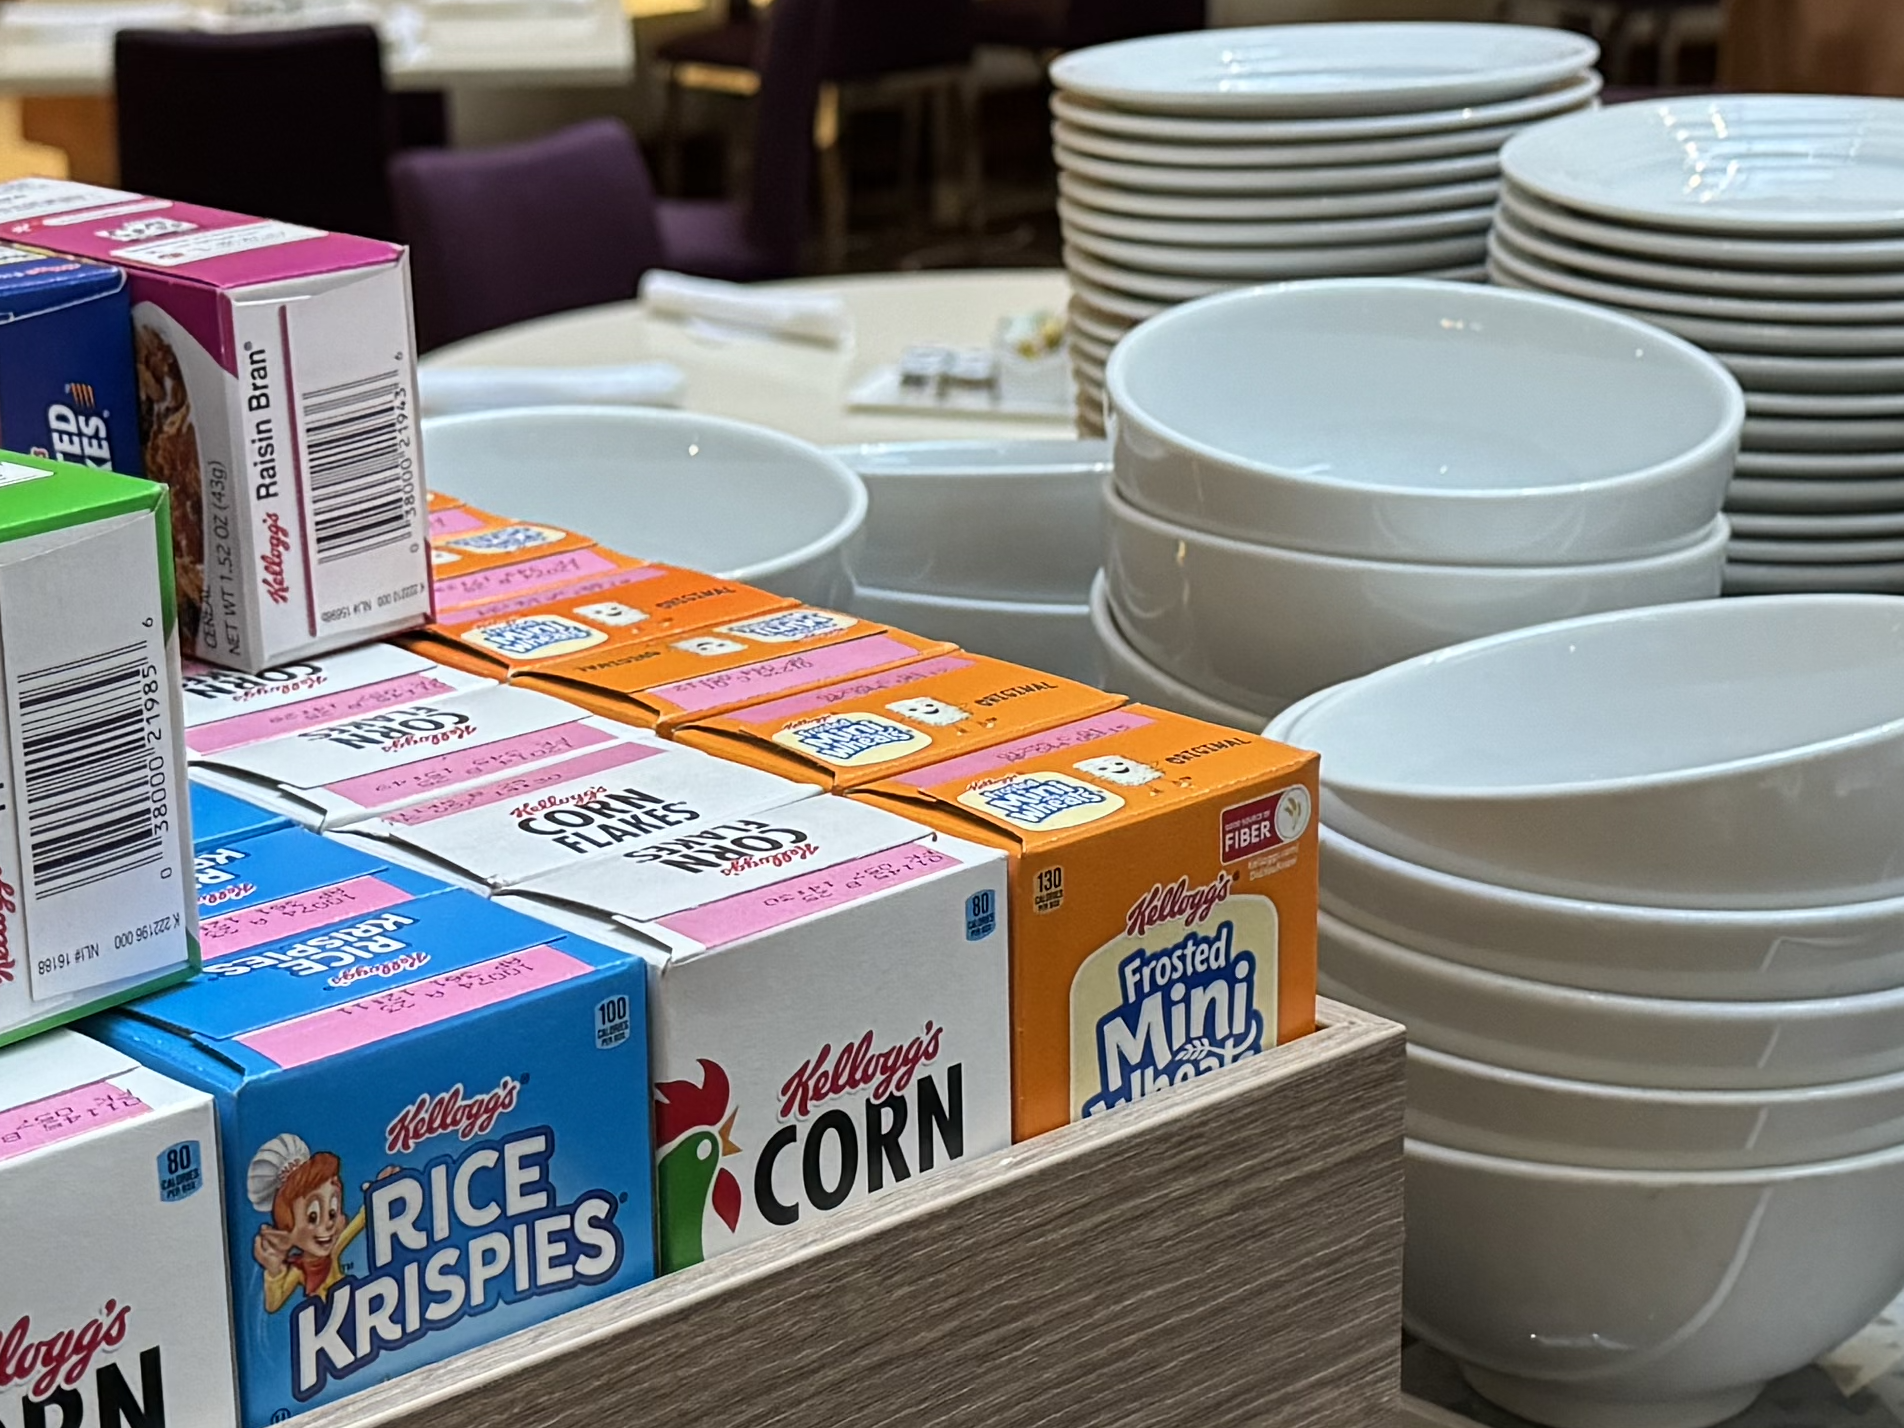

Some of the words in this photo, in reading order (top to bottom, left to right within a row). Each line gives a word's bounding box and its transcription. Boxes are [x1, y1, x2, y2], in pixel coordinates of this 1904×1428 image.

[395, 387, 411, 448] 21943
[251, 420, 280, 500] Raisin
[209, 461, 227, 511] (43g)
[399, 458, 417, 517] 38000
[213, 518, 229, 538] OZ
[216, 544, 233, 582] 1.52
[260, 512, 292, 604] Kellogg's
[142, 616, 154, 628] 6
[222, 592, 236, 612] WT
[229, 628, 240, 655] NET
[142, 663, 163, 745] 21985
[974, 681, 1058, 709] ORIGINAL
[298, 706, 441, 742] FLAKES
[329, 712, 470, 750] CORN
[1165, 736, 1251, 765] ORIGINAL
[147, 754, 171, 839] 38000
[518, 788, 665, 836] CORN
[552, 801, 700, 854] FLAKES
[623, 820, 771, 864] FLAKES
[1225, 821, 1271, 852] FIBER
[660, 827, 808, 874] CORN
[160, 867, 173, 880] 0
[1037, 866, 1062, 893] 130
[172, 912, 181, 930] K
[972, 892, 988, 916] 80
[1127, 871, 1231, 937] Kellogg's
[113, 933, 134, 950] 000
[135, 915, 173, 943] 222196
[202, 913, 414, 976] KRISPIES
[38, 951, 72, 976] 16188
[74, 942, 100, 961] NLI#
[278, 935, 407, 976] RICE
[1124, 926, 1228, 1004] Frosted
[598, 995, 627, 1023] 100
[1103, 960, 1250, 1092] Mini
[780, 1018, 943, 1124] Kellogg's
[386, 1076, 519, 1155] Kellogg's
[166, 1146, 192, 1174] 80
[752, 1063, 966, 1227] CORN
[373, 1132, 549, 1269] RICE
[297, 1197, 617, 1394] KRISPIES
